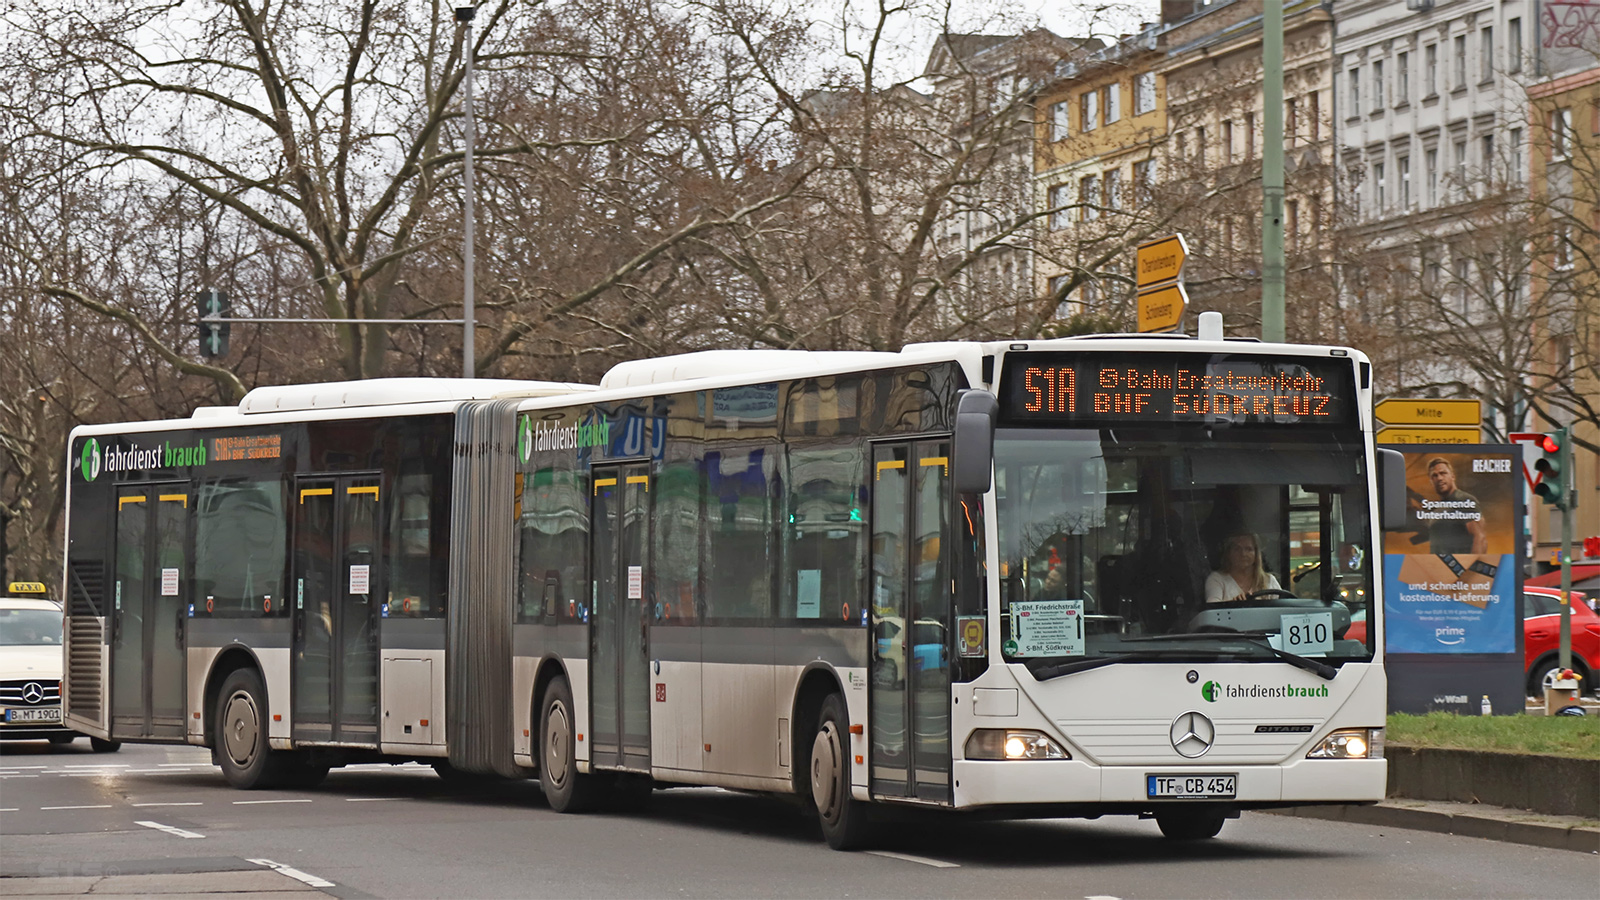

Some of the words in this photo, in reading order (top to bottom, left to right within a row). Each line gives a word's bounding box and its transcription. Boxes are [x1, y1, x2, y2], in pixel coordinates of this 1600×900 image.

[1025, 367, 1075, 412] S1A
[1178, 370, 1324, 391] Ersatzverkehr
[1094, 393, 1159, 413] BHF.
[1173, 394, 1329, 416] SÜDKREUZ
[1416, 408, 1442, 417] Mitte
[104, 444, 162, 472] fahrdienst
[165, 439, 206, 467] brauch
[1472, 459, 1511, 472] REACHER
[1421, 499, 1476, 510] Spannende
[1416, 510, 1481, 521] Unterhaltung
[15, 584, 41, 592] TAXI
[1408, 581, 1427, 590] und
[1429, 581, 1469, 590] schnelle
[1471, 581, 1490, 590] und
[1399, 592, 1451, 602] kostenlose
[1453, 592, 1500, 603] Lieferung
[1289, 623, 1327, 645] 810
[1435, 626, 1465, 637] prime
[1444, 695, 1468, 704] Wall
[11, 710, 18, 719] B
[23, 710, 35, 719] MT
[38, 709, 60, 719] 1901
[1157, 778, 1176, 793] TF
[1185, 778, 1204, 793] CB
[1207, 778, 1234, 793] 454
